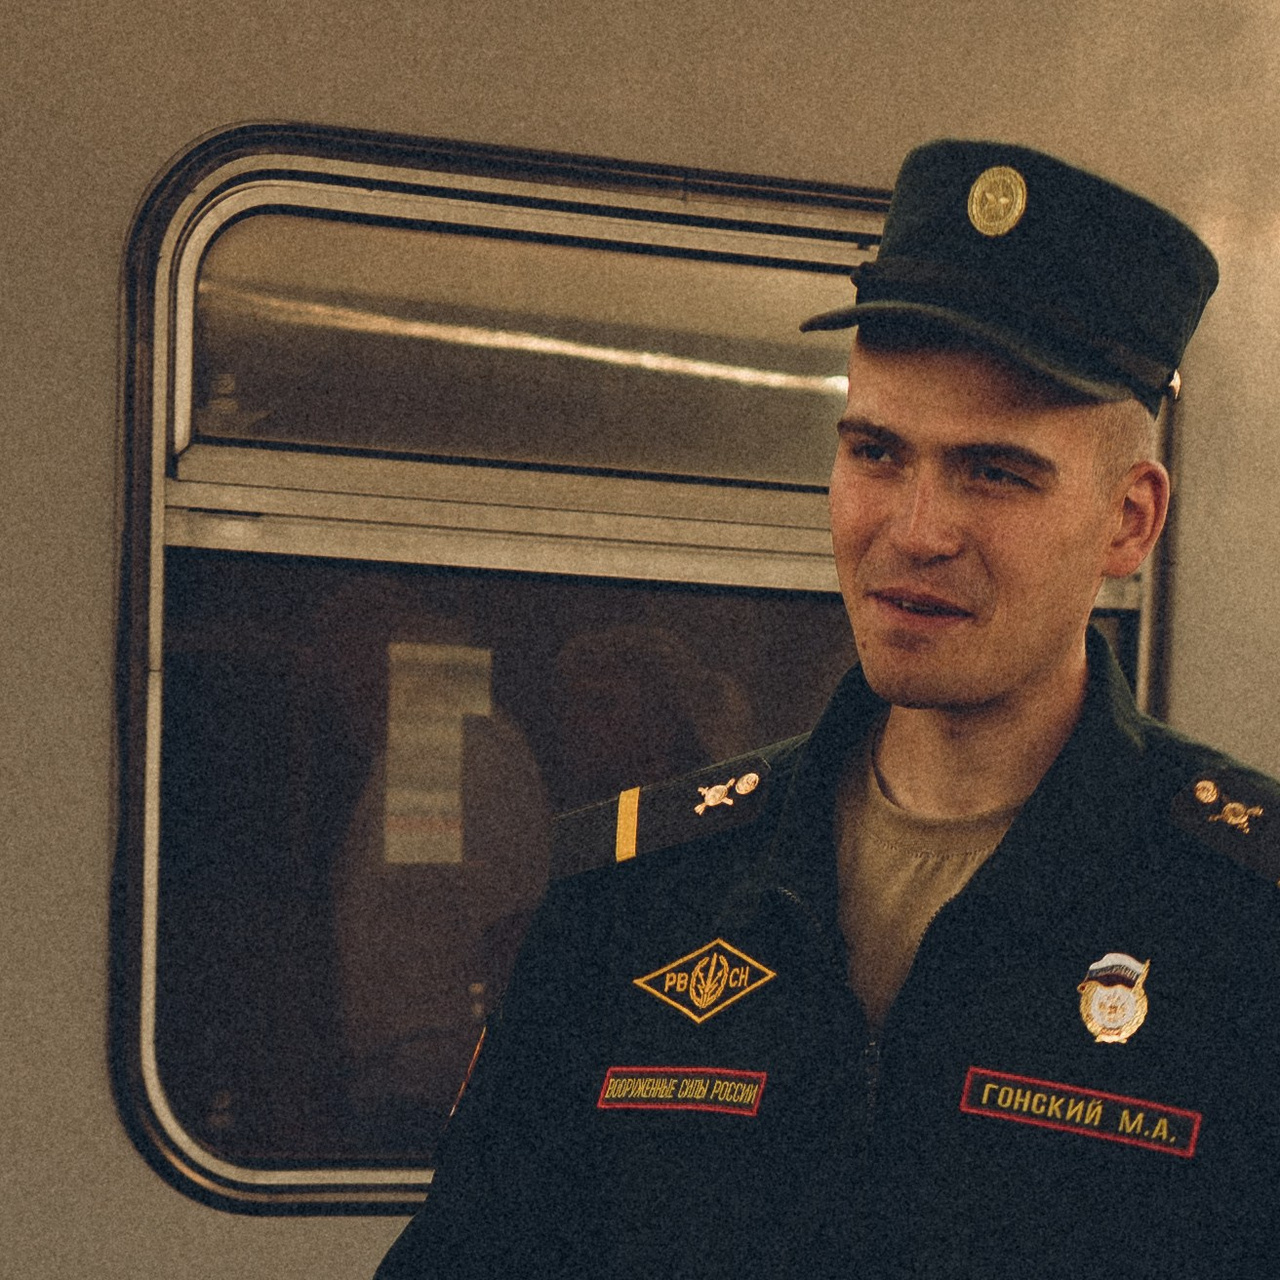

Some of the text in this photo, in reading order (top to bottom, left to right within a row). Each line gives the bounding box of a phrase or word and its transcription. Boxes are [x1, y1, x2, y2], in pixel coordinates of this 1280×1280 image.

[605, 1078, 759, 1104] ВООРУЖЕННЫЕ СИЛЫ РОССИИ
[981, 1083, 1177, 1142] ГОНСКИЙ М.А.
